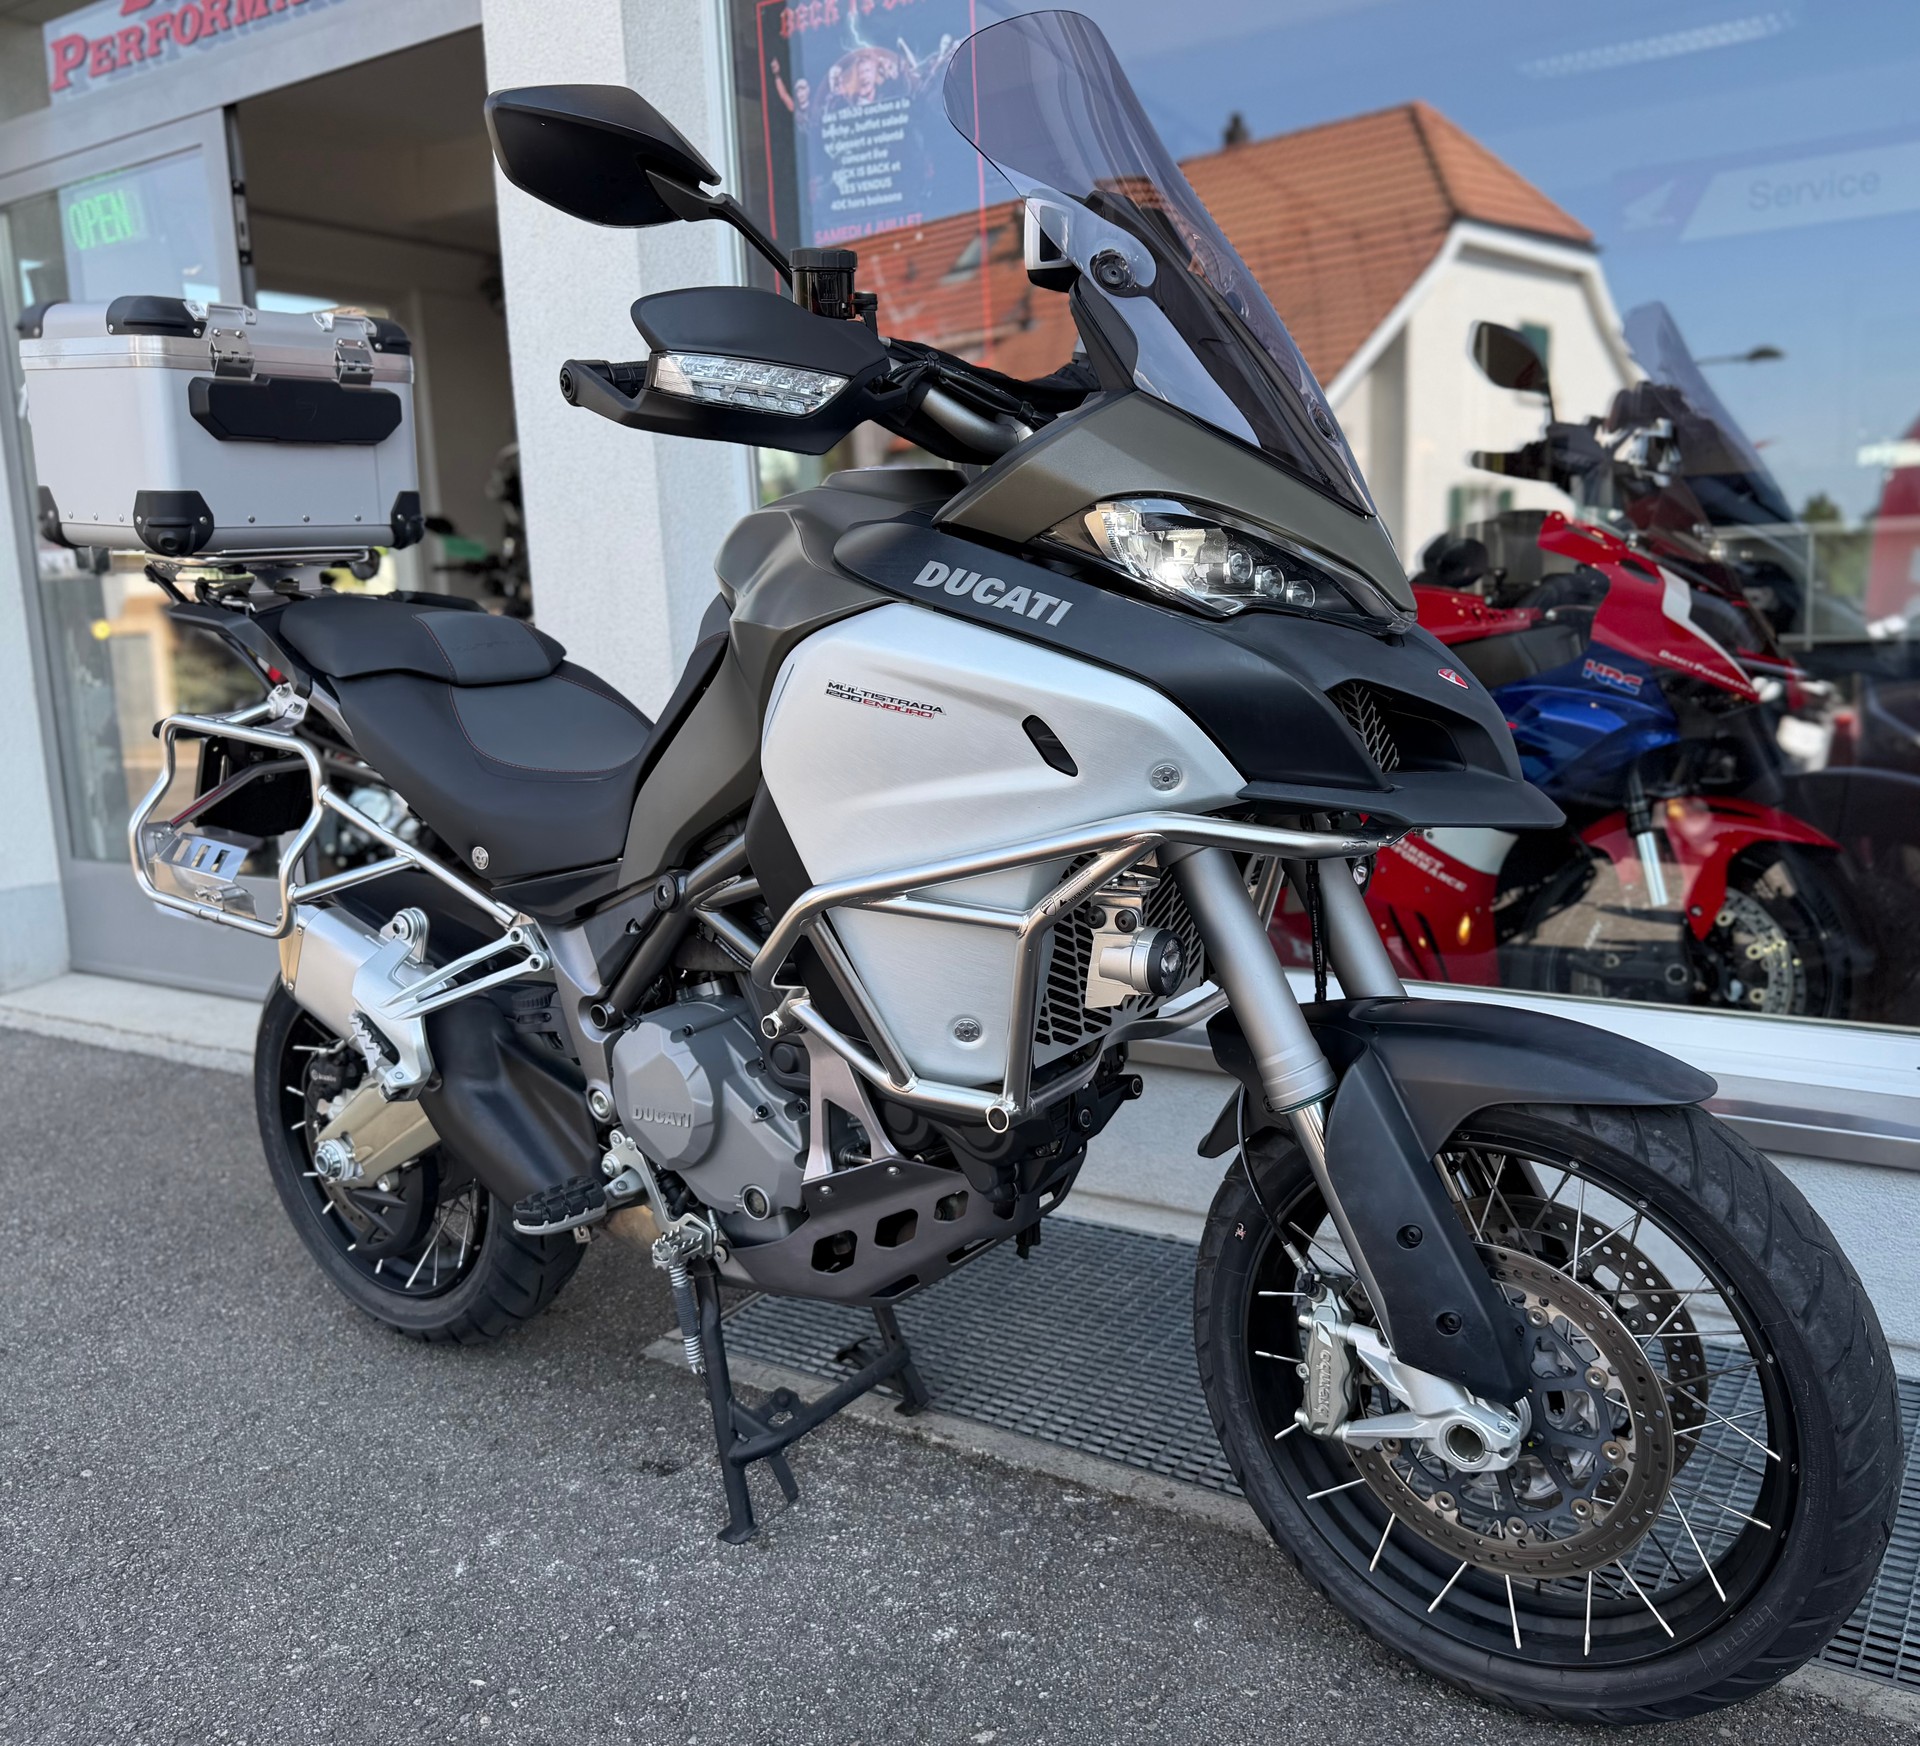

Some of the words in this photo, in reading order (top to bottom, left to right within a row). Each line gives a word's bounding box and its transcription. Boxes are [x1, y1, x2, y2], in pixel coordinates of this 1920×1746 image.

[50, 0, 311, 92] PERFORM
[867, 162, 890, 176] BACK
[1748, 169, 1882, 211] Service
[68, 190, 134, 250] OPEN
[816, 223, 862, 245] SAMEDI
[875, 212, 923, 233] JUILLET
[912, 560, 1074, 627] DUCATI
[1581, 658, 1644, 696] HRC
[825, 688, 863, 704] 1200
[861, 697, 934, 719] ENDURO
[827, 680, 945, 714] MULTISTRADA
[631, 1104, 691, 1129] DUCATI
